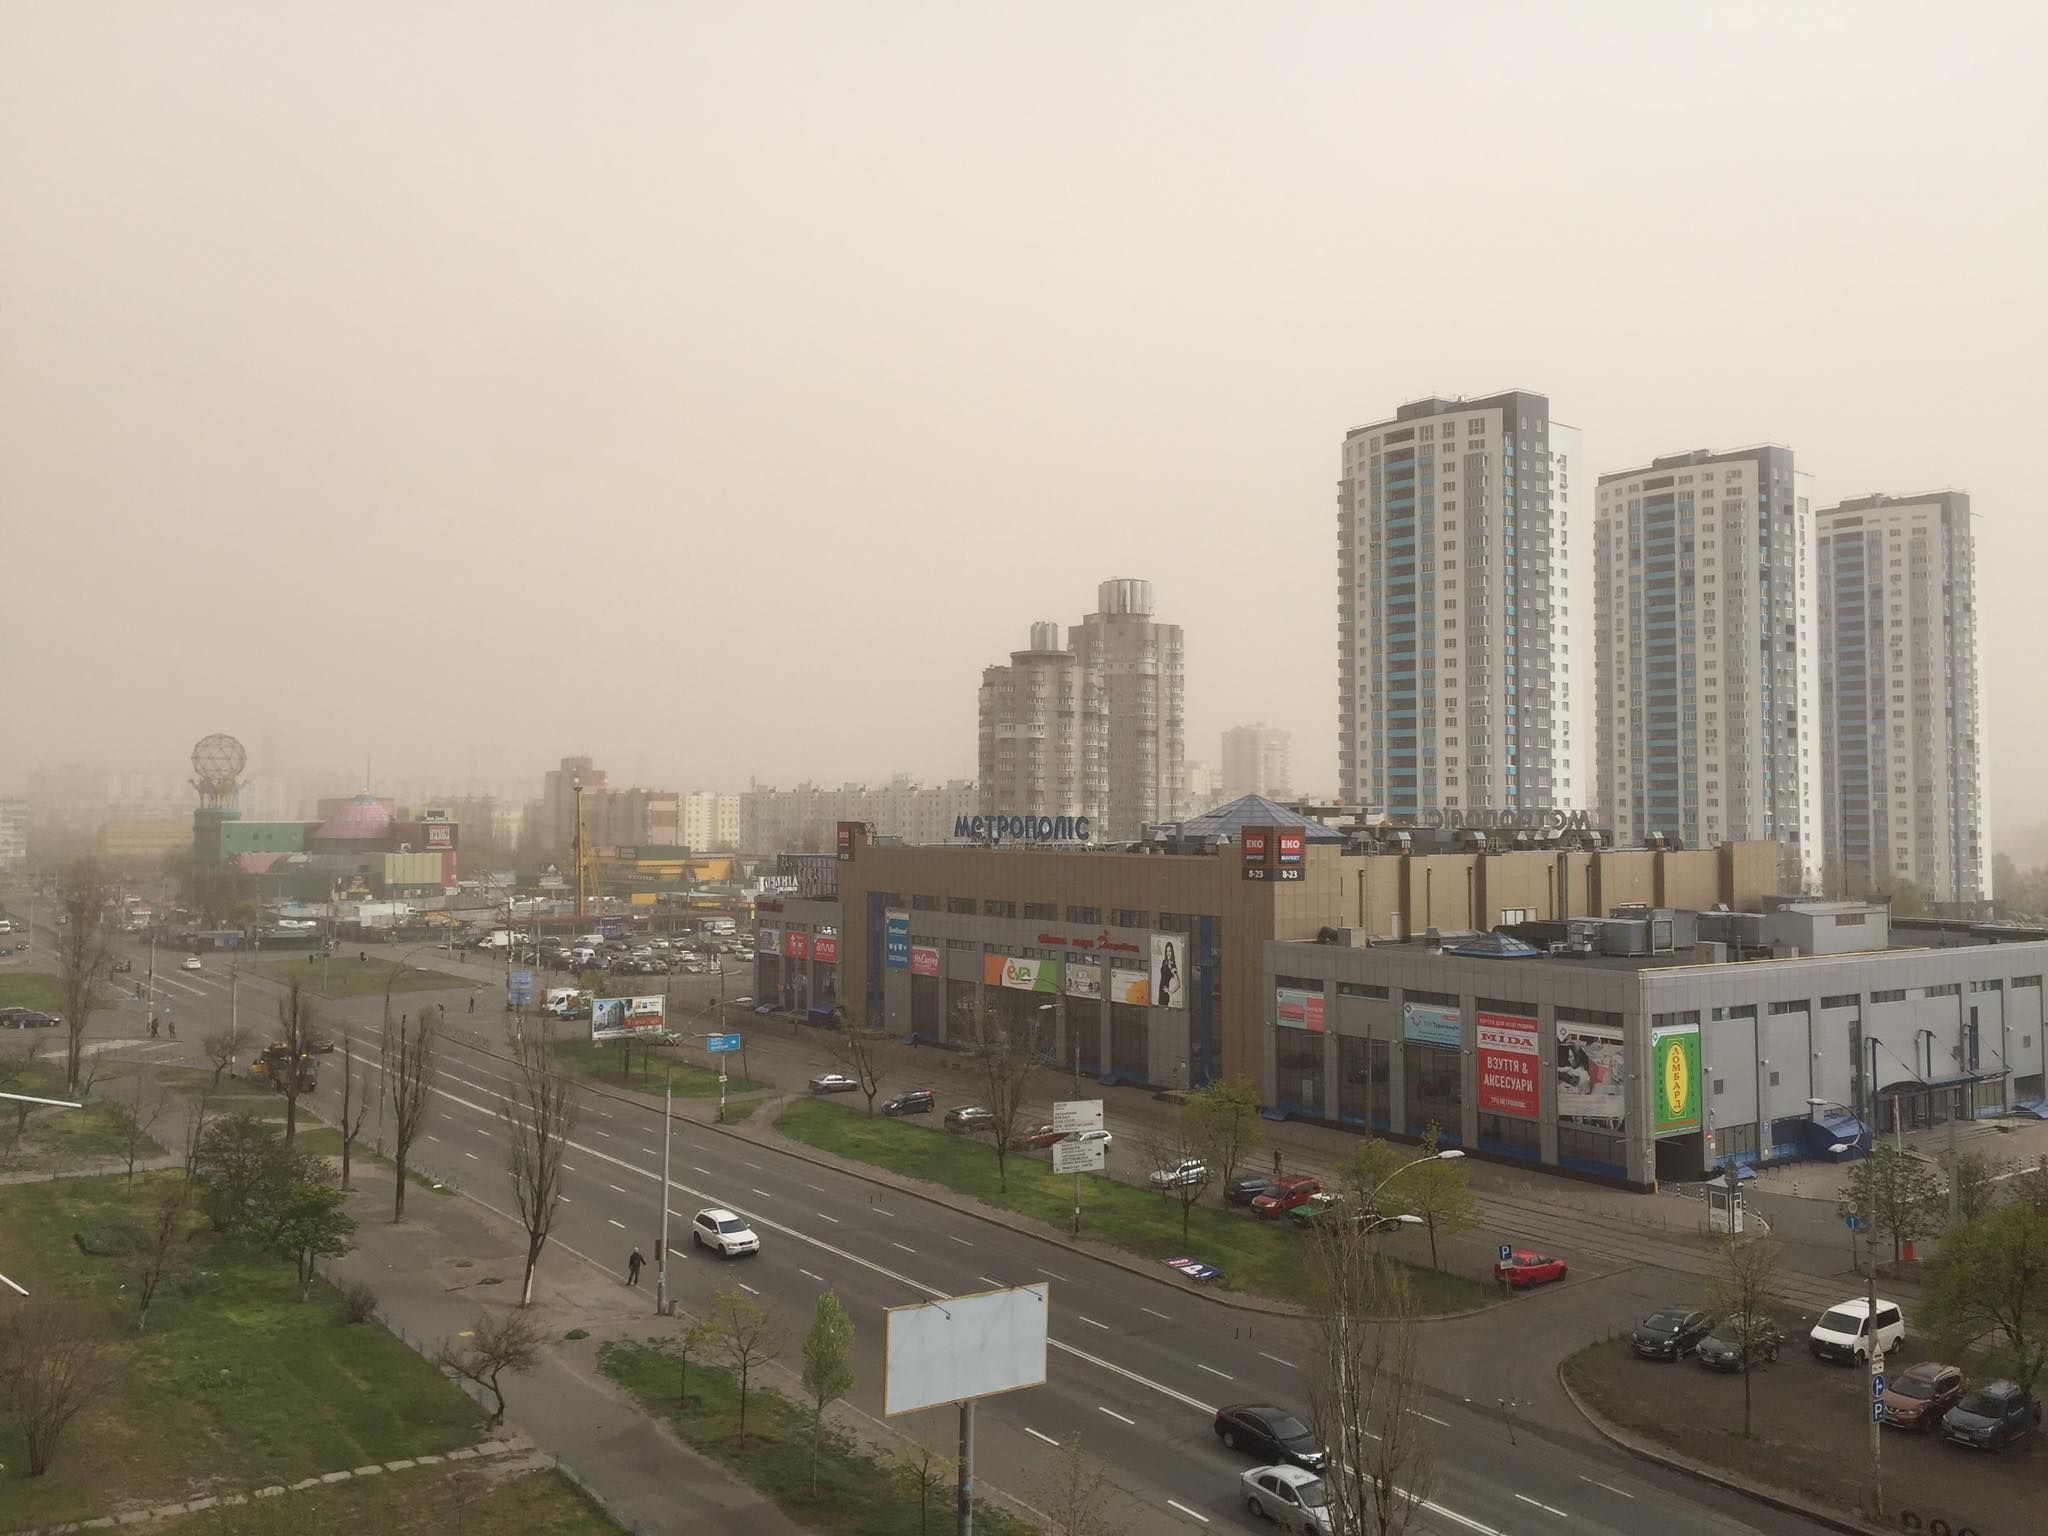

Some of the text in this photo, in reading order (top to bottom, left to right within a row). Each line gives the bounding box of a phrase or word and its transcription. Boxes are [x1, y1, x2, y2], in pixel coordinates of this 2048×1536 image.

[1281, 839, 1300, 849] ЕКО
[1282, 870, 1298, 879] 8-23
[1481, 1033, 1534, 1047] MIDA
[1487, 1056, 1529, 1074] ВЗУТТЯ &
[1483, 1074, 1533, 1092] АКСЕСУАРИ
[1672, 1047, 1682, 1109] ЛОМБАРД
[1502, 1246, 1509, 1259] P
[1875, 1404, 1882, 1418] P
